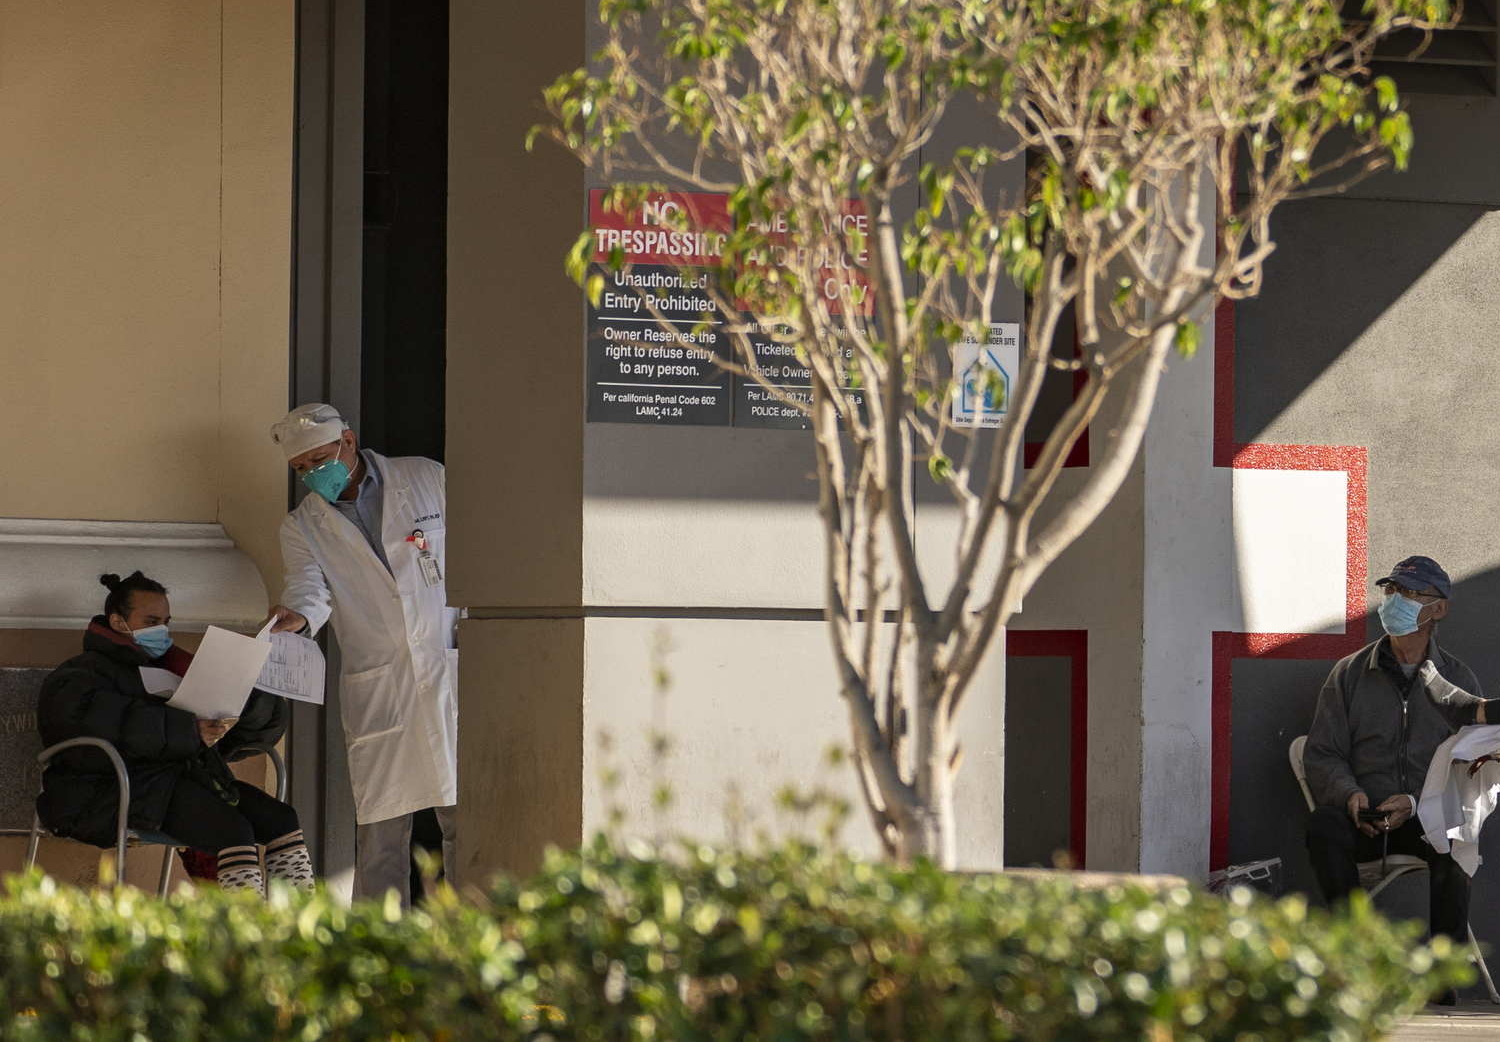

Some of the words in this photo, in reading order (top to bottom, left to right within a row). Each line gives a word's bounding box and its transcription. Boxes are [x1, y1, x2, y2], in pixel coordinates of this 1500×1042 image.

[642, 200, 680, 226] NO
[615, 271, 707, 289] Unauthorized
[605, 292, 641, 312] Entry
[645, 294, 716, 312] Prohibited
[604, 327, 641, 341] Owner
[644, 329, 695, 343] Reserves
[698, 331, 716, 343] the
[1004, 337, 1016, 346] SITE
[605, 344, 631, 360] right
[634, 346, 646, 358] to
[648, 346, 683, 359] refuse
[686, 348, 714, 363] entry
[619, 361, 631, 374] to
[634, 363, 654, 377] any
[657, 363, 699, 378] person.
[603, 392, 616, 402] Per
[618, 393, 653, 404] california
[655, 394, 677, 404] Penal
[678, 395, 700, 405] Code
[701, 396, 716, 405] 602
[747, 390, 760, 401] Per
[636, 406, 660, 416] LAMC
[661, 407, 683, 417] 41.24
[751, 405, 779, 417] POLICE
[781, 406, 800, 418] dept.
